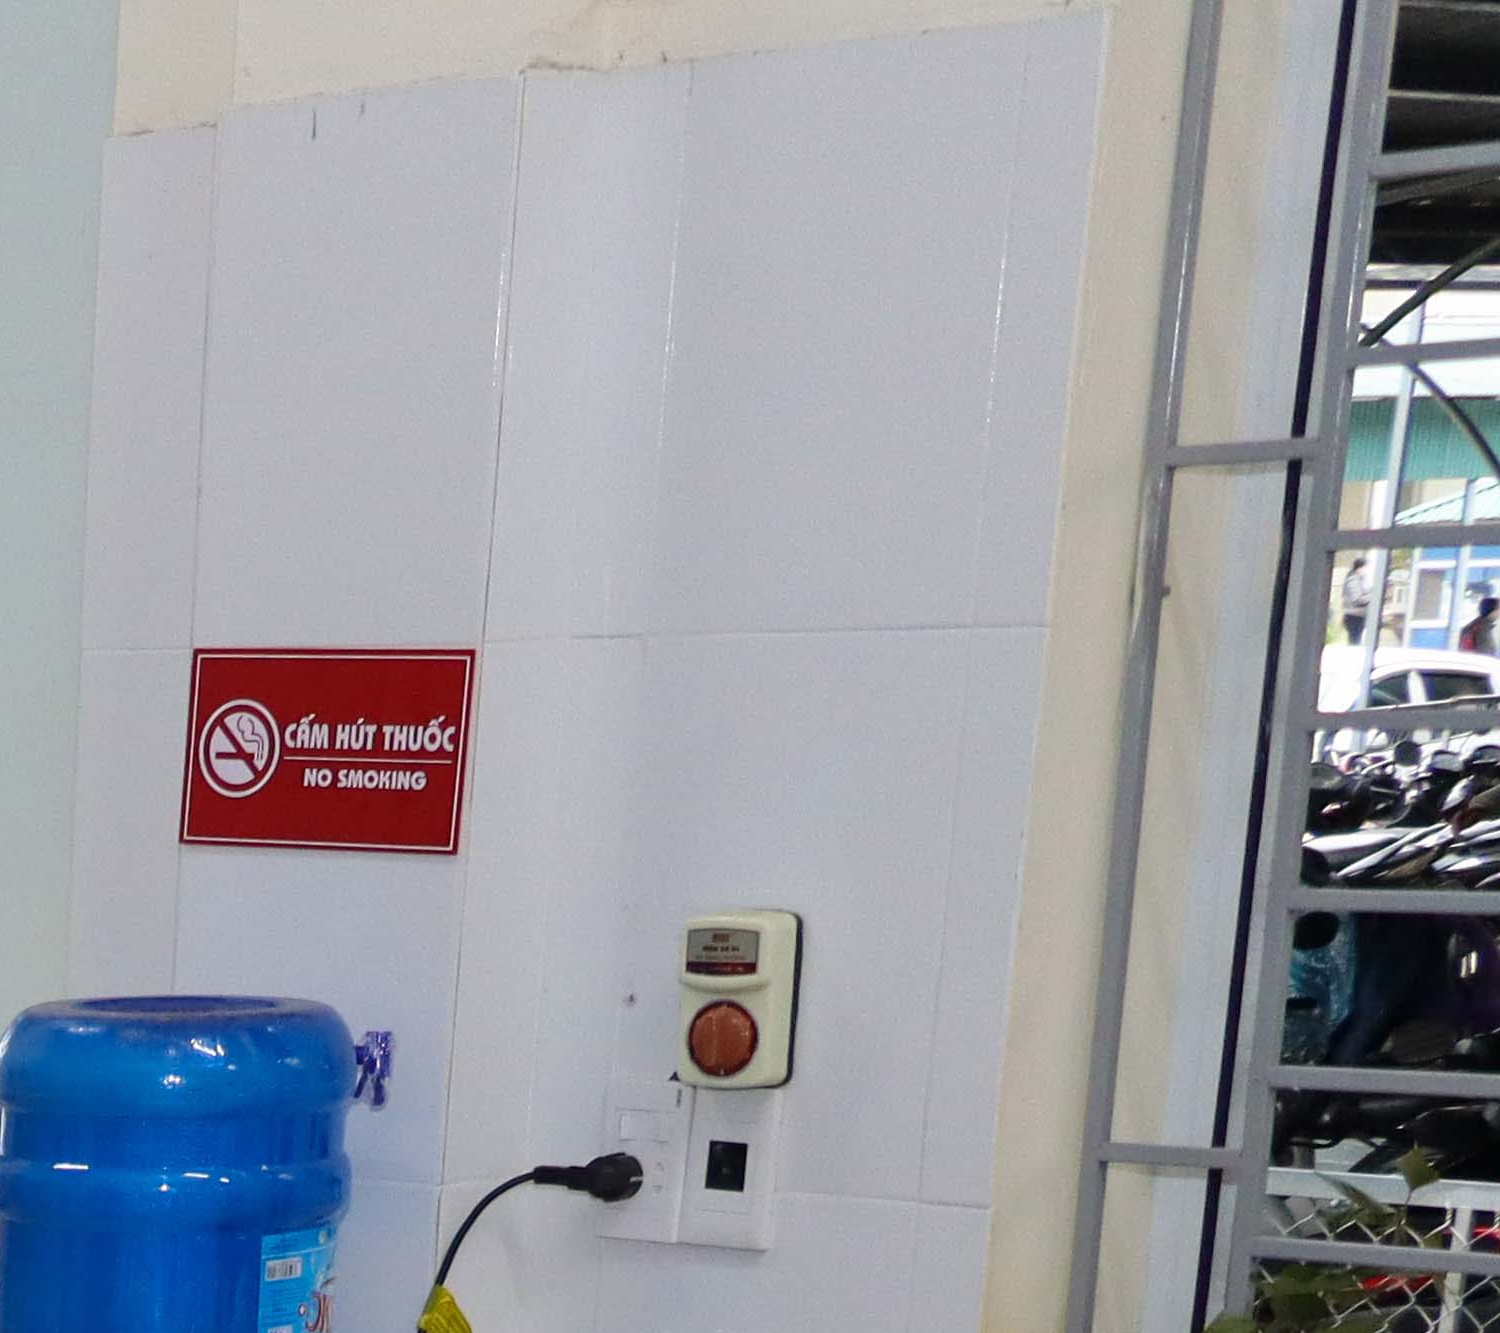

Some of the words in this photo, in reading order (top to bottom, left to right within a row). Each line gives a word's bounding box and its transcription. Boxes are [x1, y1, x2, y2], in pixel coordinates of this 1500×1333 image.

[284, 713, 329, 750] CẤM
[335, 718, 378, 751] HÚT
[382, 715, 456, 752] THUỐC
[303, 767, 333, 788] NO
[336, 768, 428, 791] SMOKING
